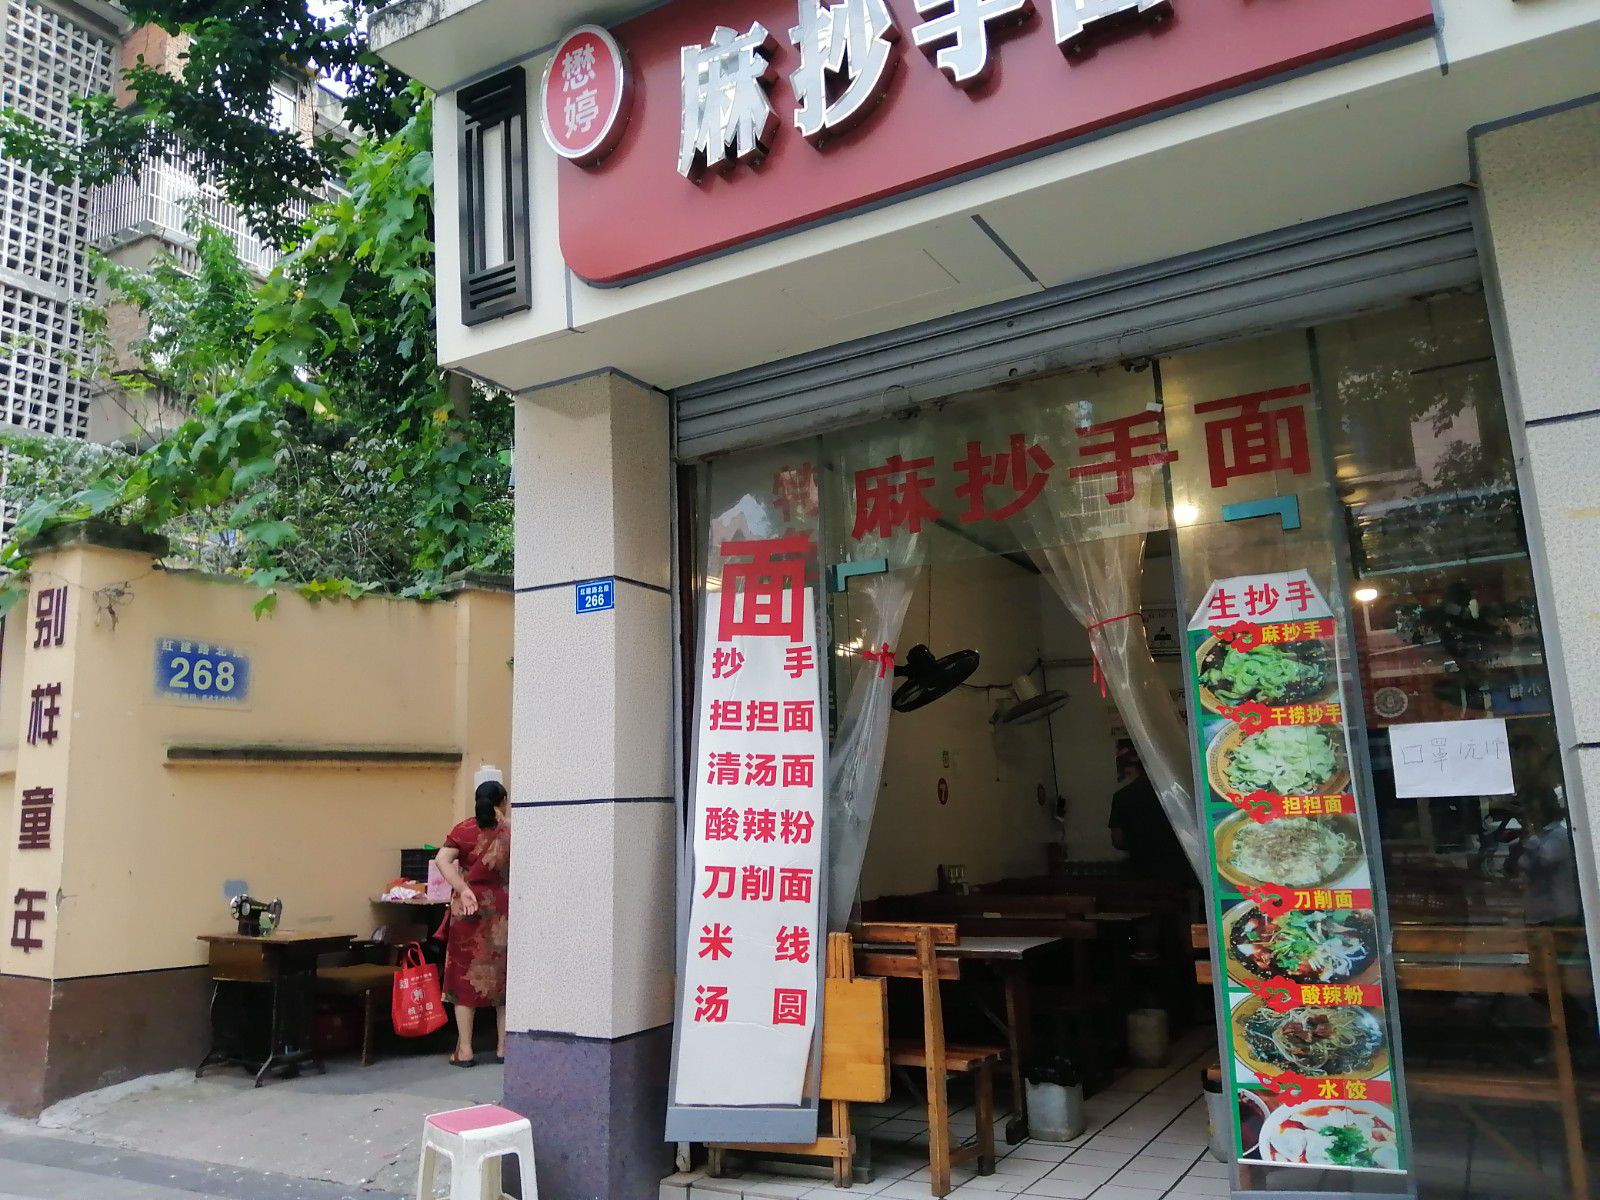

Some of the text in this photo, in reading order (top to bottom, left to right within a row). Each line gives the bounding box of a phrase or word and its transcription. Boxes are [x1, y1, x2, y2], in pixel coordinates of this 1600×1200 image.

[562, 43, 599, 139] 懋婷
[852, 383, 1311, 541] 麻抄手面
[585, 593, 605, 607] 266
[717, 536, 809, 642] 面
[1207, 579, 1316, 621] 生抄手
[1261, 621, 1322, 644] 麻抄手
[169, 657, 235, 692] 268
[712, 646, 814, 679] 抄手
[709, 700, 814, 732] 担担面
[1271, 703, 1342, 726] 干捞抄手
[706, 752, 814, 787] 清汤面
[1282, 795, 1342, 816] 担担面
[704, 807, 815, 844] 酸辣粉
[702, 865, 814, 903] 刀削面
[1294, 889, 1353, 909] 刀削面
[698, 923, 810, 963] 米线
[694, 984, 807, 1026] 汤圆
[1301, 985, 1364, 1006] 酸辣粉
[1317, 1080, 1367, 1100] 水饺
